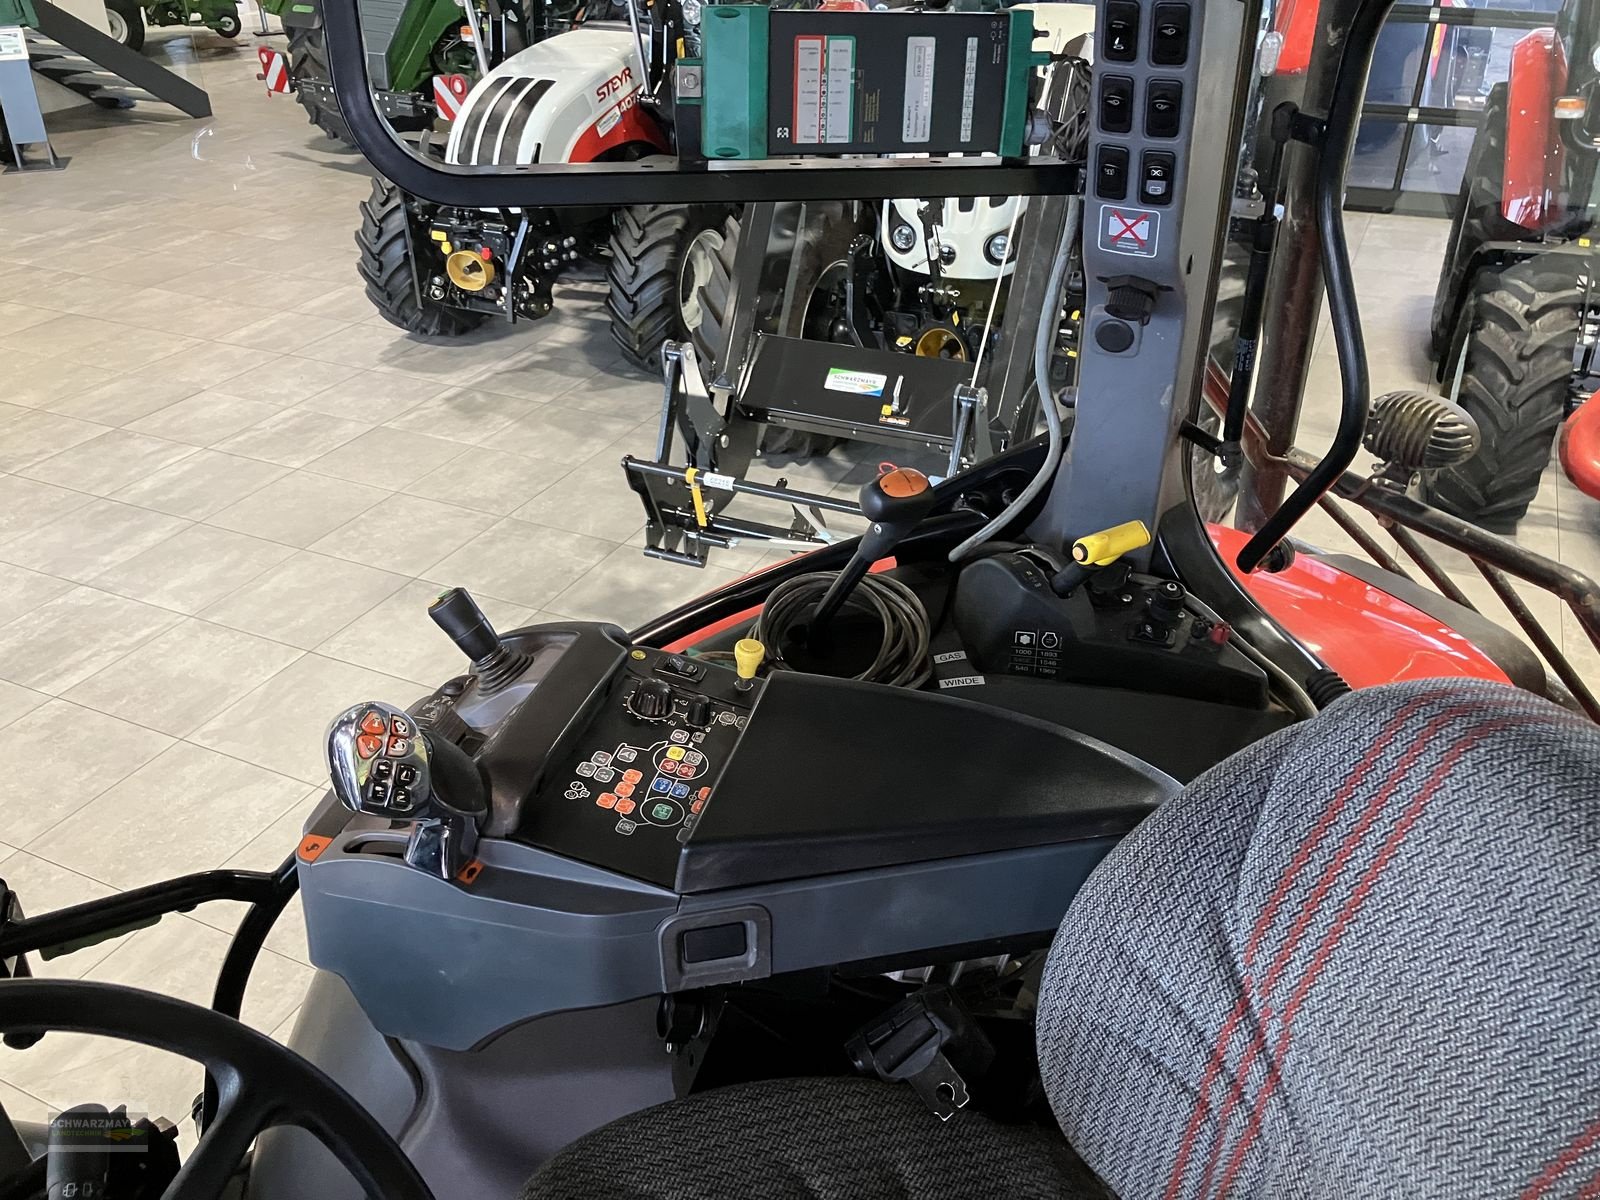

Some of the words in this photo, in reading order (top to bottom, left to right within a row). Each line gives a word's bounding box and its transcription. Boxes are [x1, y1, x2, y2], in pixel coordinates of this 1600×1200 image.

[596, 67, 633, 104] STEYR
[939, 653, 962, 662] GAS
[944, 677, 979, 687] WINDE
